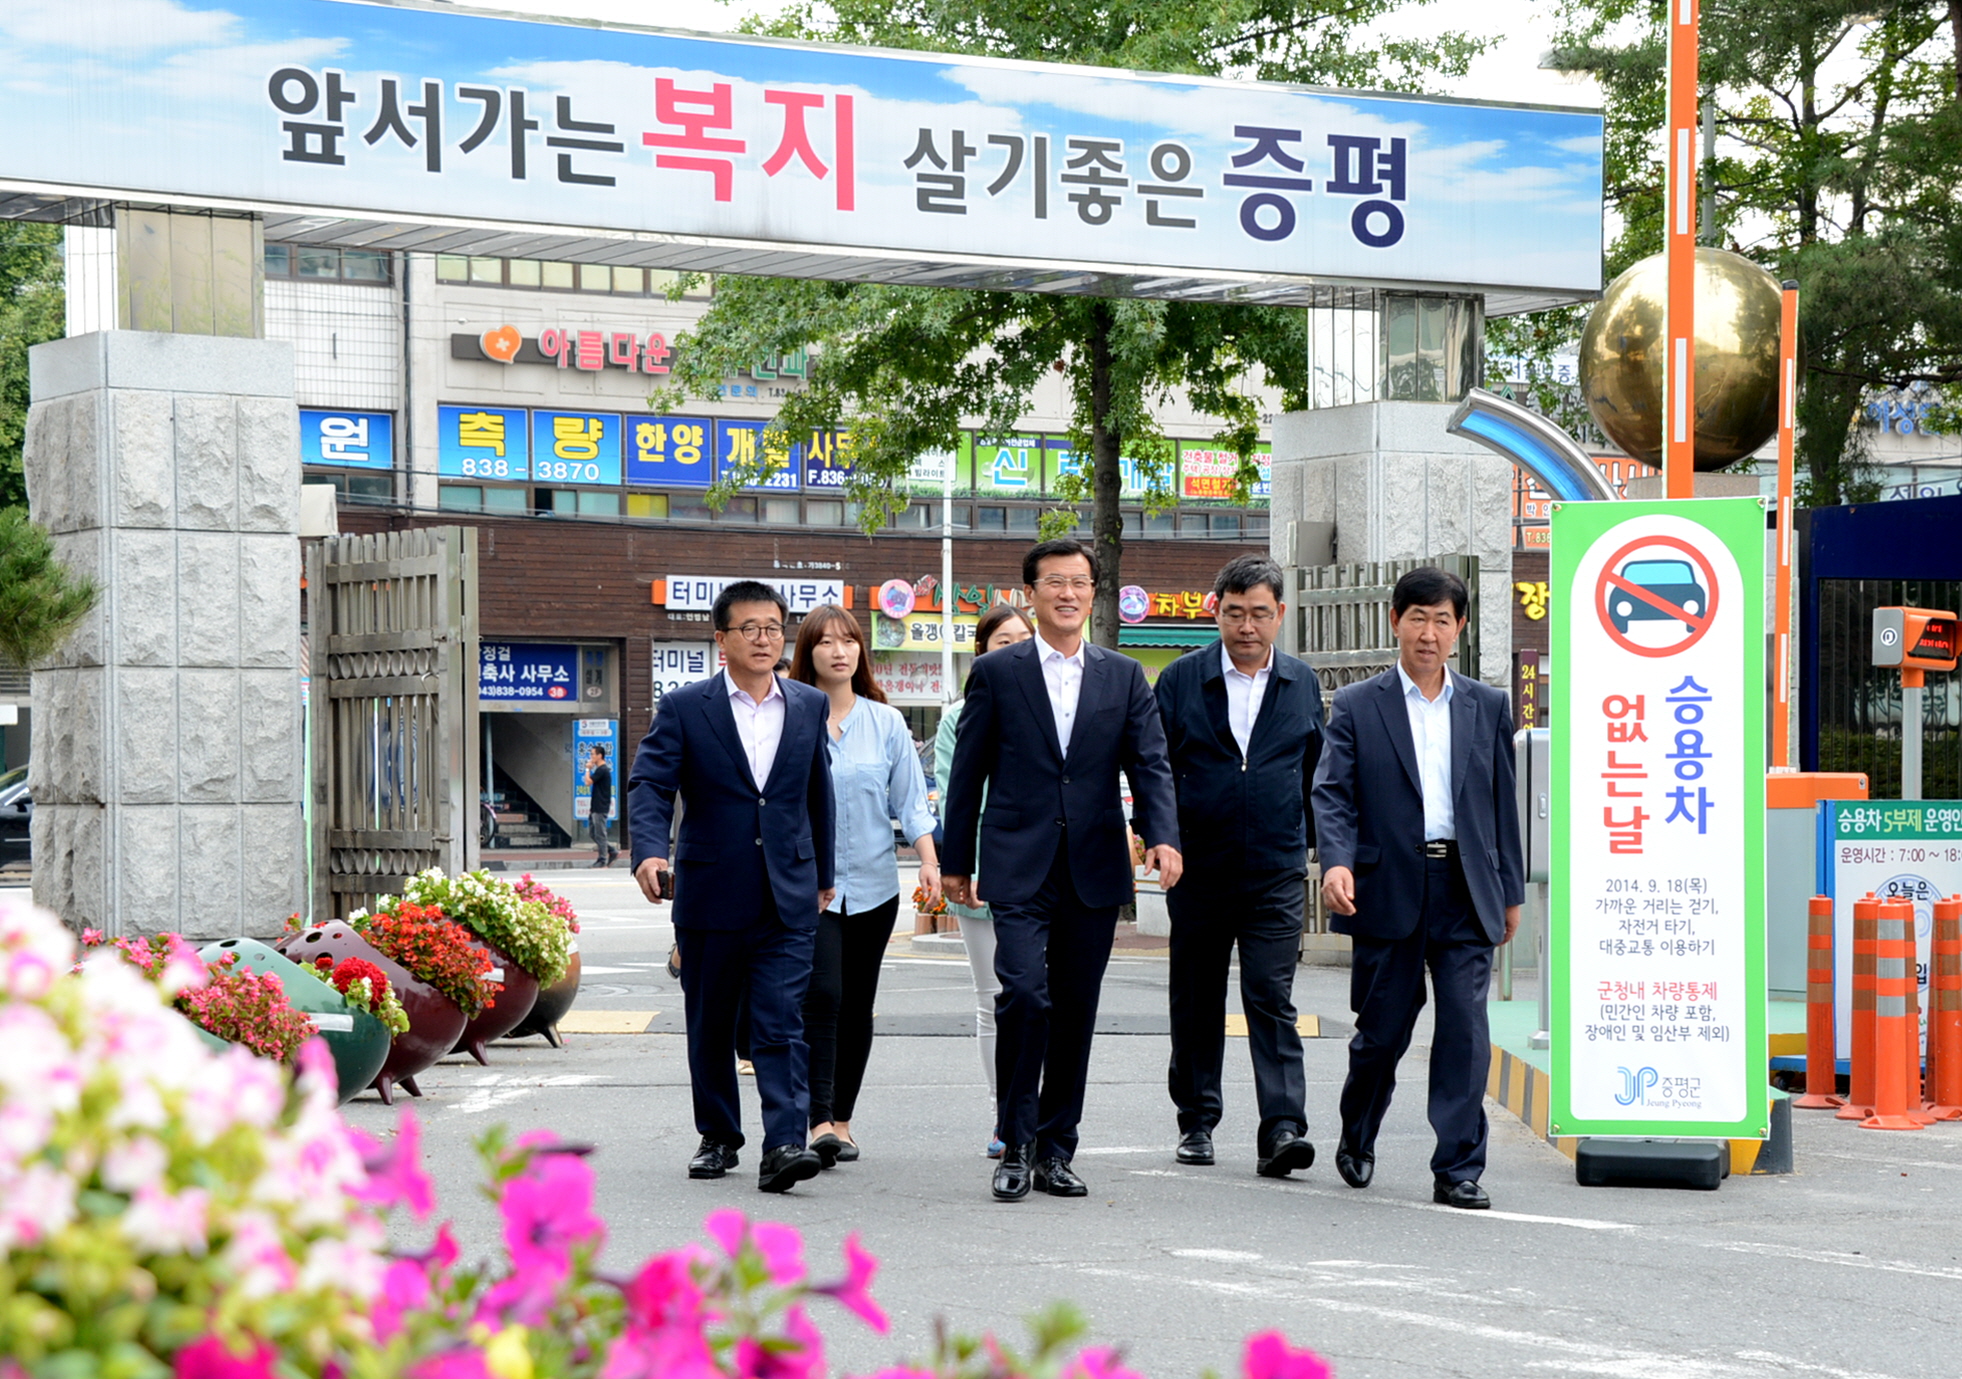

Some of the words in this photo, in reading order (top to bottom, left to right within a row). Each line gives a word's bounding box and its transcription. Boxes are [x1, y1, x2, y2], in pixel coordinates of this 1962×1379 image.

[267, 67, 625, 188] 앞서가는
[642, 77, 856, 212] 복지
[903, 127, 1205, 230] 살기좋은
[1222, 124, 1408, 249] 증평
[538, 328, 671, 375] 아름다운
[319, 414, 370, 463] 원
[635, 422, 704, 464] 한양
[993, 447, 1030, 488] 신
[520, 663, 570, 683] 사무소
[1664, 675, 1716, 835] 승용차
[1837, 807, 1883, 834] 승용차
[1883, 808, 1923, 834] 5부제
[1840, 846, 1887, 864] 운영시간
[1898, 847, 1926, 863] 7:00
[1605, 878, 1643, 893] 2014.
[1647, 878, 1661, 893] 9.
[1666, 877, 1708, 895] 18(목)
[1595, 897, 1638, 915] 가까운
[1642, 897, 1684, 915] 거리는
[1688, 897, 1720, 916] 걷기,
[1618, 917, 1659, 936] 자전거
[1663, 917, 1696, 937] 타기,
[1599, 938, 1656, 957] 대중교통
[1659, 938, 1715, 957] 이용하기
[1596, 980, 1645, 1002] 군청내
[1651, 980, 1718, 1002] 차량통제
[1600, 1003, 1646, 1021] (민간인
[1650, 1003, 1680, 1022] 차량
[1683, 1003, 1717, 1022] 포함,
[1584, 1023, 1627, 1042] 장애인
[1631, 1023, 1646, 1042] 및
[1649, 1024, 1693, 1042] 임산부
[1696, 1024, 1731, 1043] 제외)
[1661, 1076, 1702, 1099] 증평군
